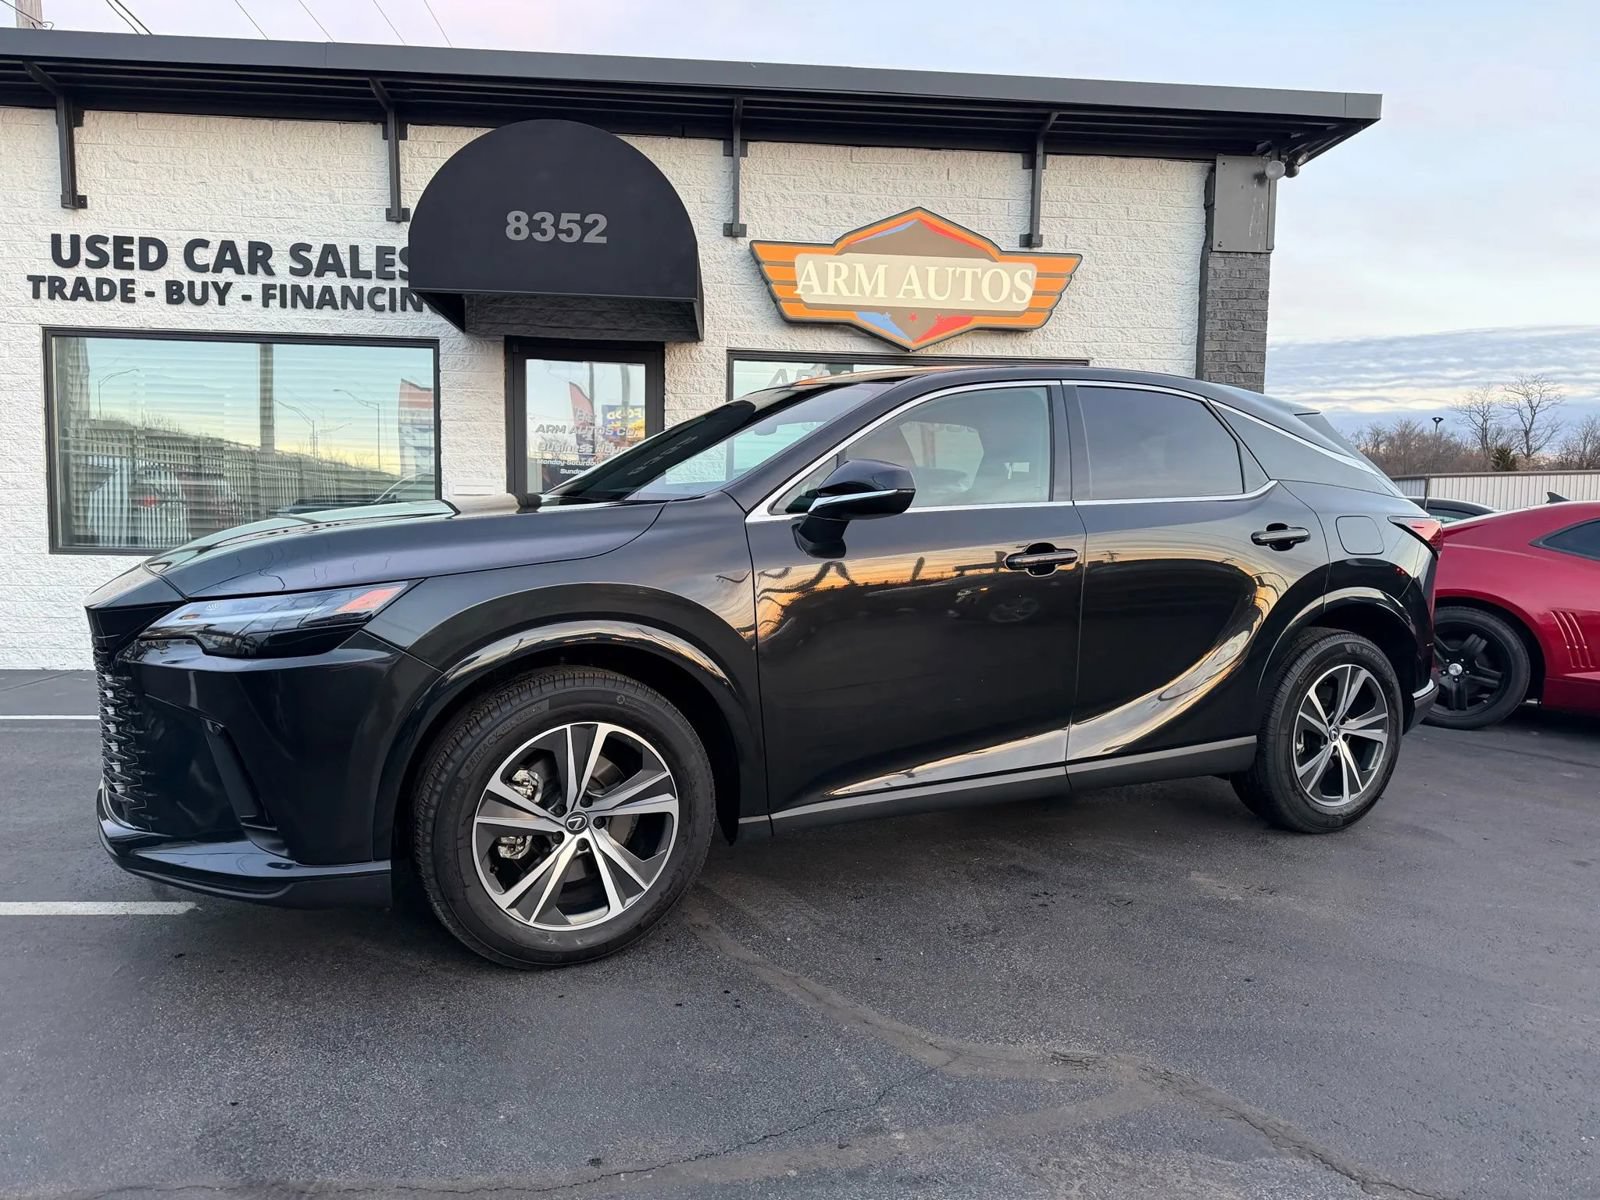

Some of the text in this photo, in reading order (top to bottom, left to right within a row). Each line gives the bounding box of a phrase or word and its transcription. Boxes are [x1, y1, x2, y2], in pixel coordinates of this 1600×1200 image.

[505, 210, 608, 244] 8352
[50, 233, 169, 272] USED
[183, 238, 276, 277] CAR
[26, 274, 136, 304] TRADE
[165, 279, 234, 306] BUY
[261, 283, 425, 313] FINANCIN
[793, 260, 1034, 304] ARM AUTOS
[535, 424, 567, 434] ARM
[569, 426, 614, 436] AUTOS
